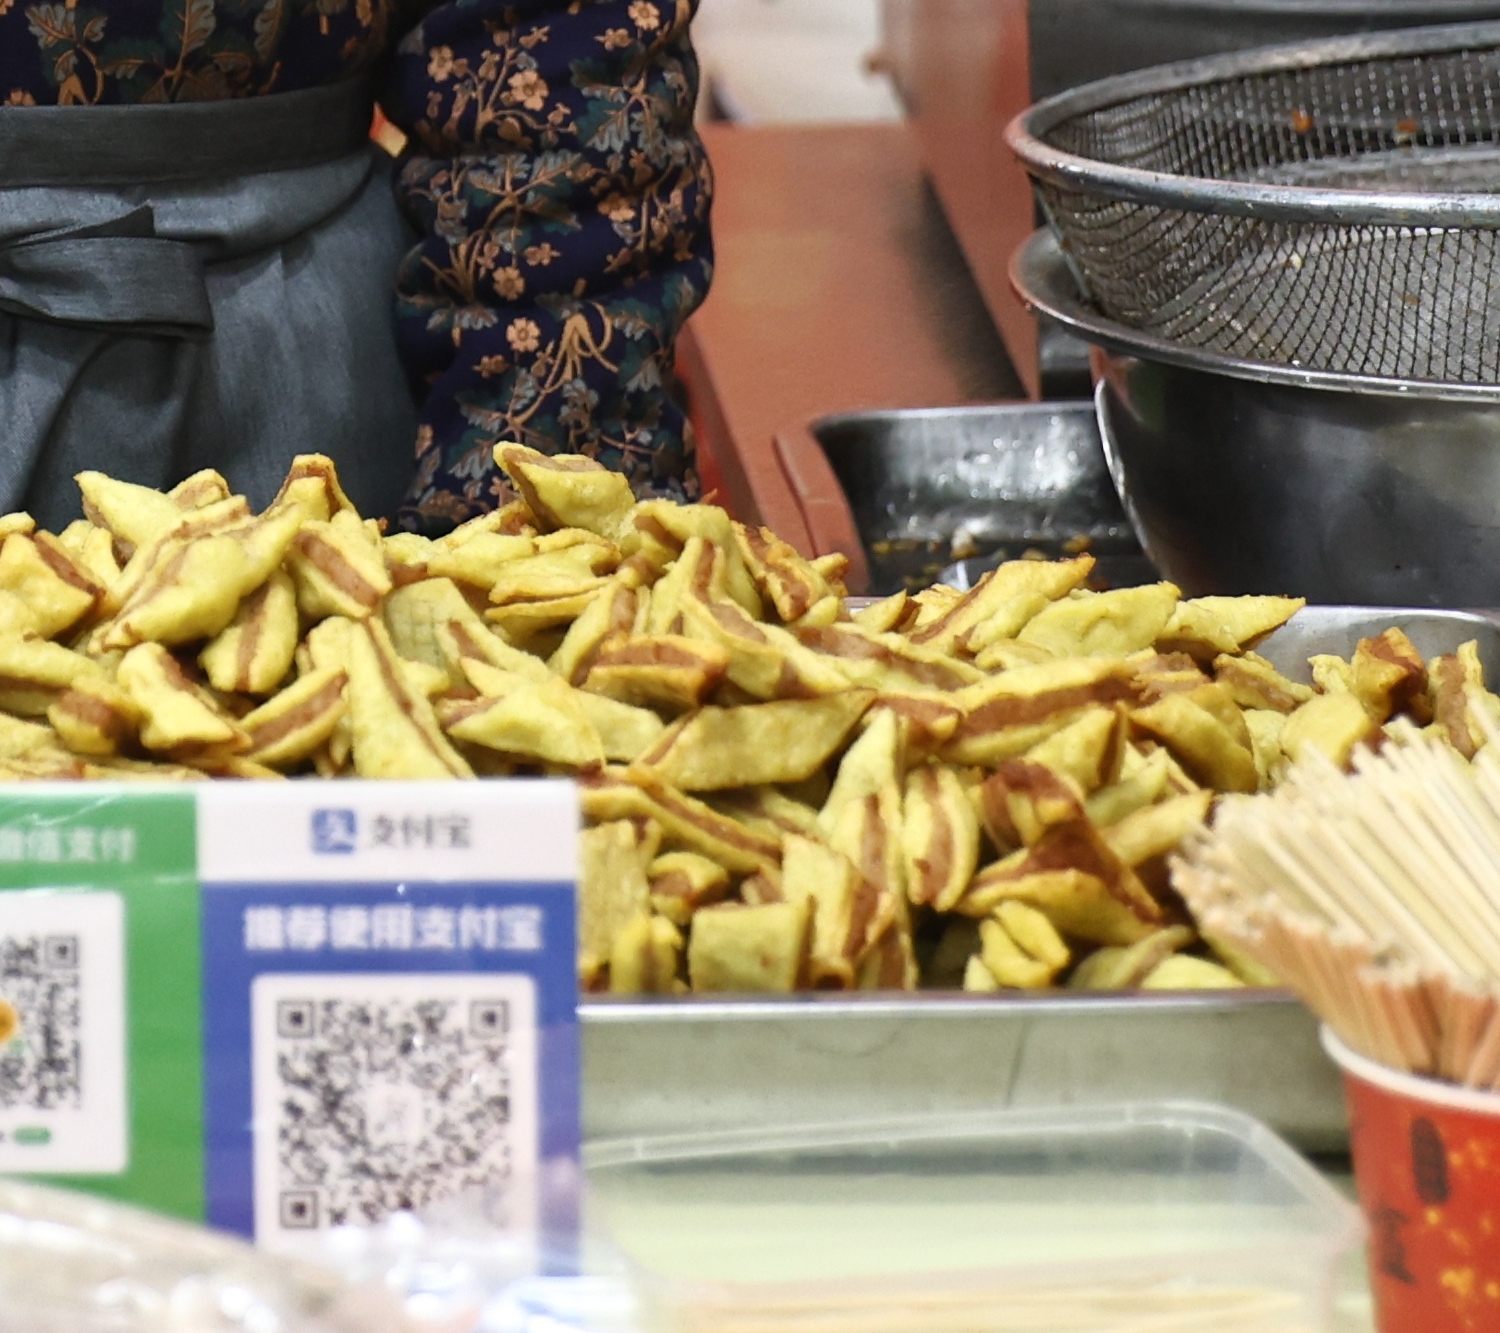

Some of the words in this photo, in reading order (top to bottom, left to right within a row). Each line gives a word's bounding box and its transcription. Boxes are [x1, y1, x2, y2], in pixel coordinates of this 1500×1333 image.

[369, 813, 472, 850] 支付宝
[244, 903, 544, 951] 推荐使用支付宝
